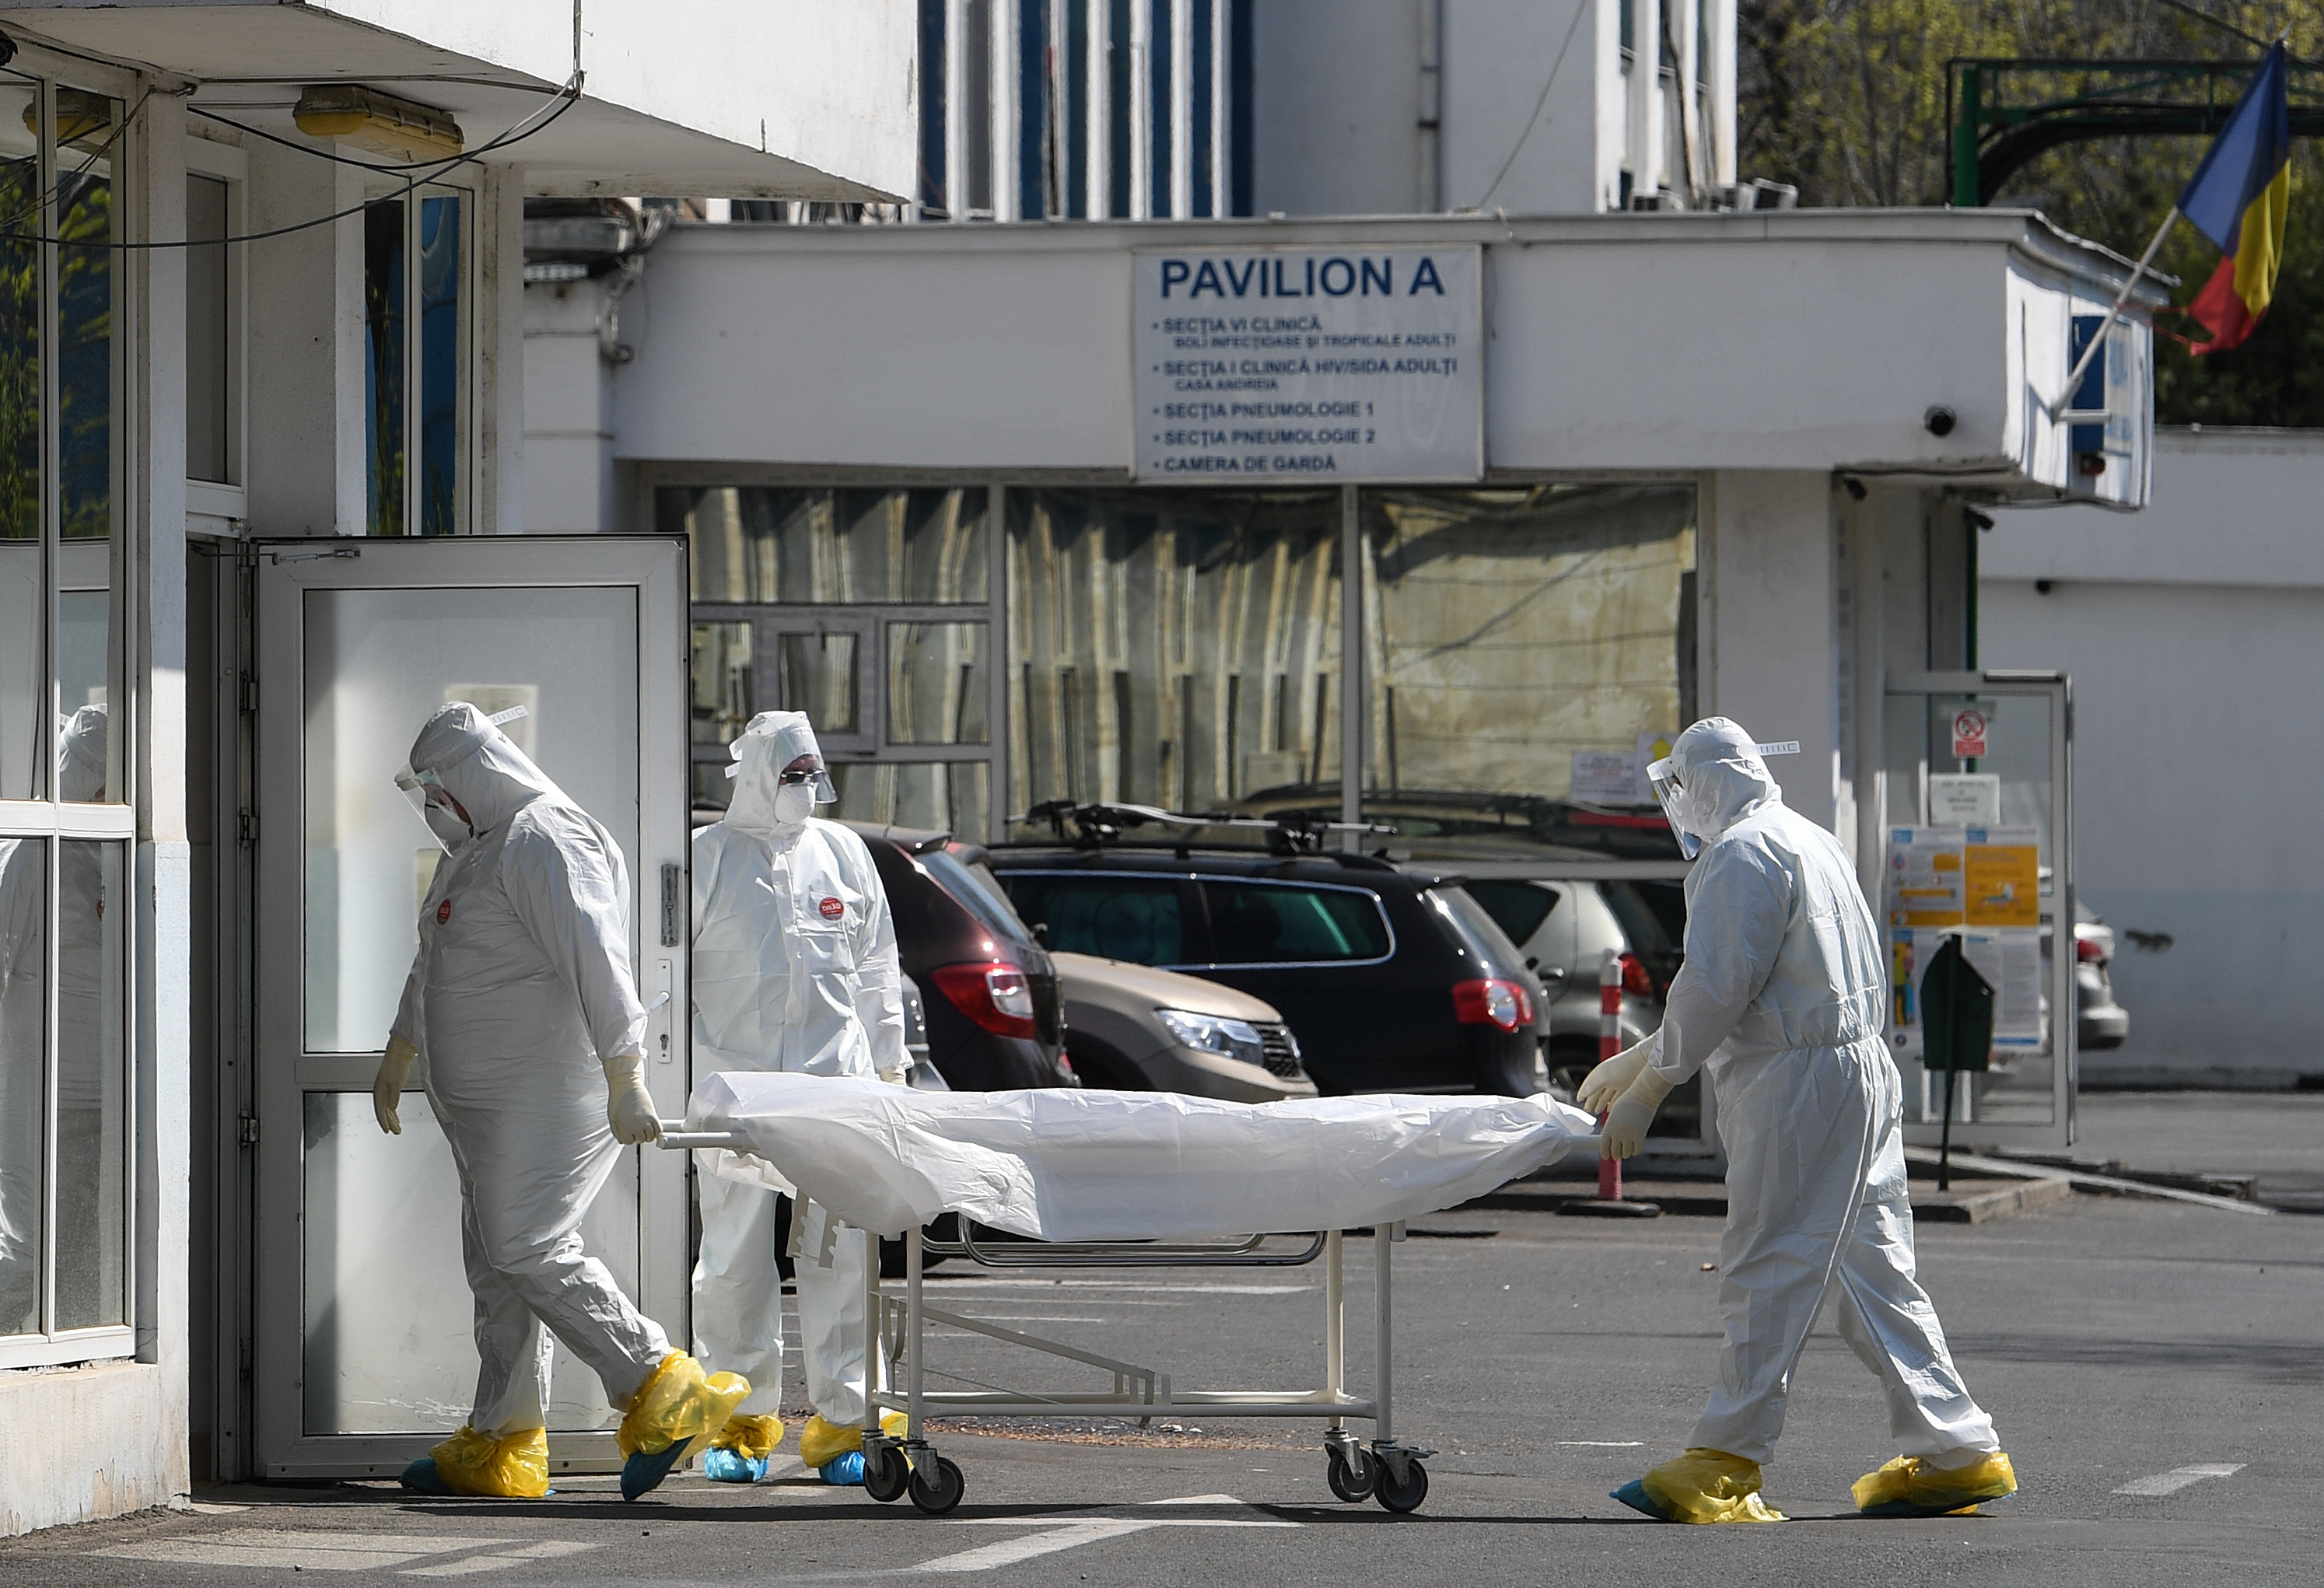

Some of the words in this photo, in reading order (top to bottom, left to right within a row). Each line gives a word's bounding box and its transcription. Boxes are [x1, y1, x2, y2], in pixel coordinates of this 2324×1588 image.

[1160, 257, 1393, 299] PAVILION
[1409, 257, 1445, 296] A
[1229, 317, 1248, 331] VI
[1251, 314, 1321, 331] CLINICĂ
[1174, 336, 1208, 348] BOLI
[1324, 334, 1401, 347] TROPICALE
[1230, 360, 1237, 373] I
[1240, 356, 1310, 373] CLINICĂ
[1315, 358, 1390, 374] HIV/SIDA
[1175, 379, 1212, 391] CASA
[1230, 401, 1360, 418] PNEUMOLOGIE
[1366, 401, 1374, 416] 1
[1230, 428, 1360, 445] PNEUMOLOGIE
[1365, 428, 1376, 443] 2
[1164, 456, 1239, 472] CAMERA
[1244, 456, 1267, 471] DE
[1272, 453, 1337, 471] GARDĂ
